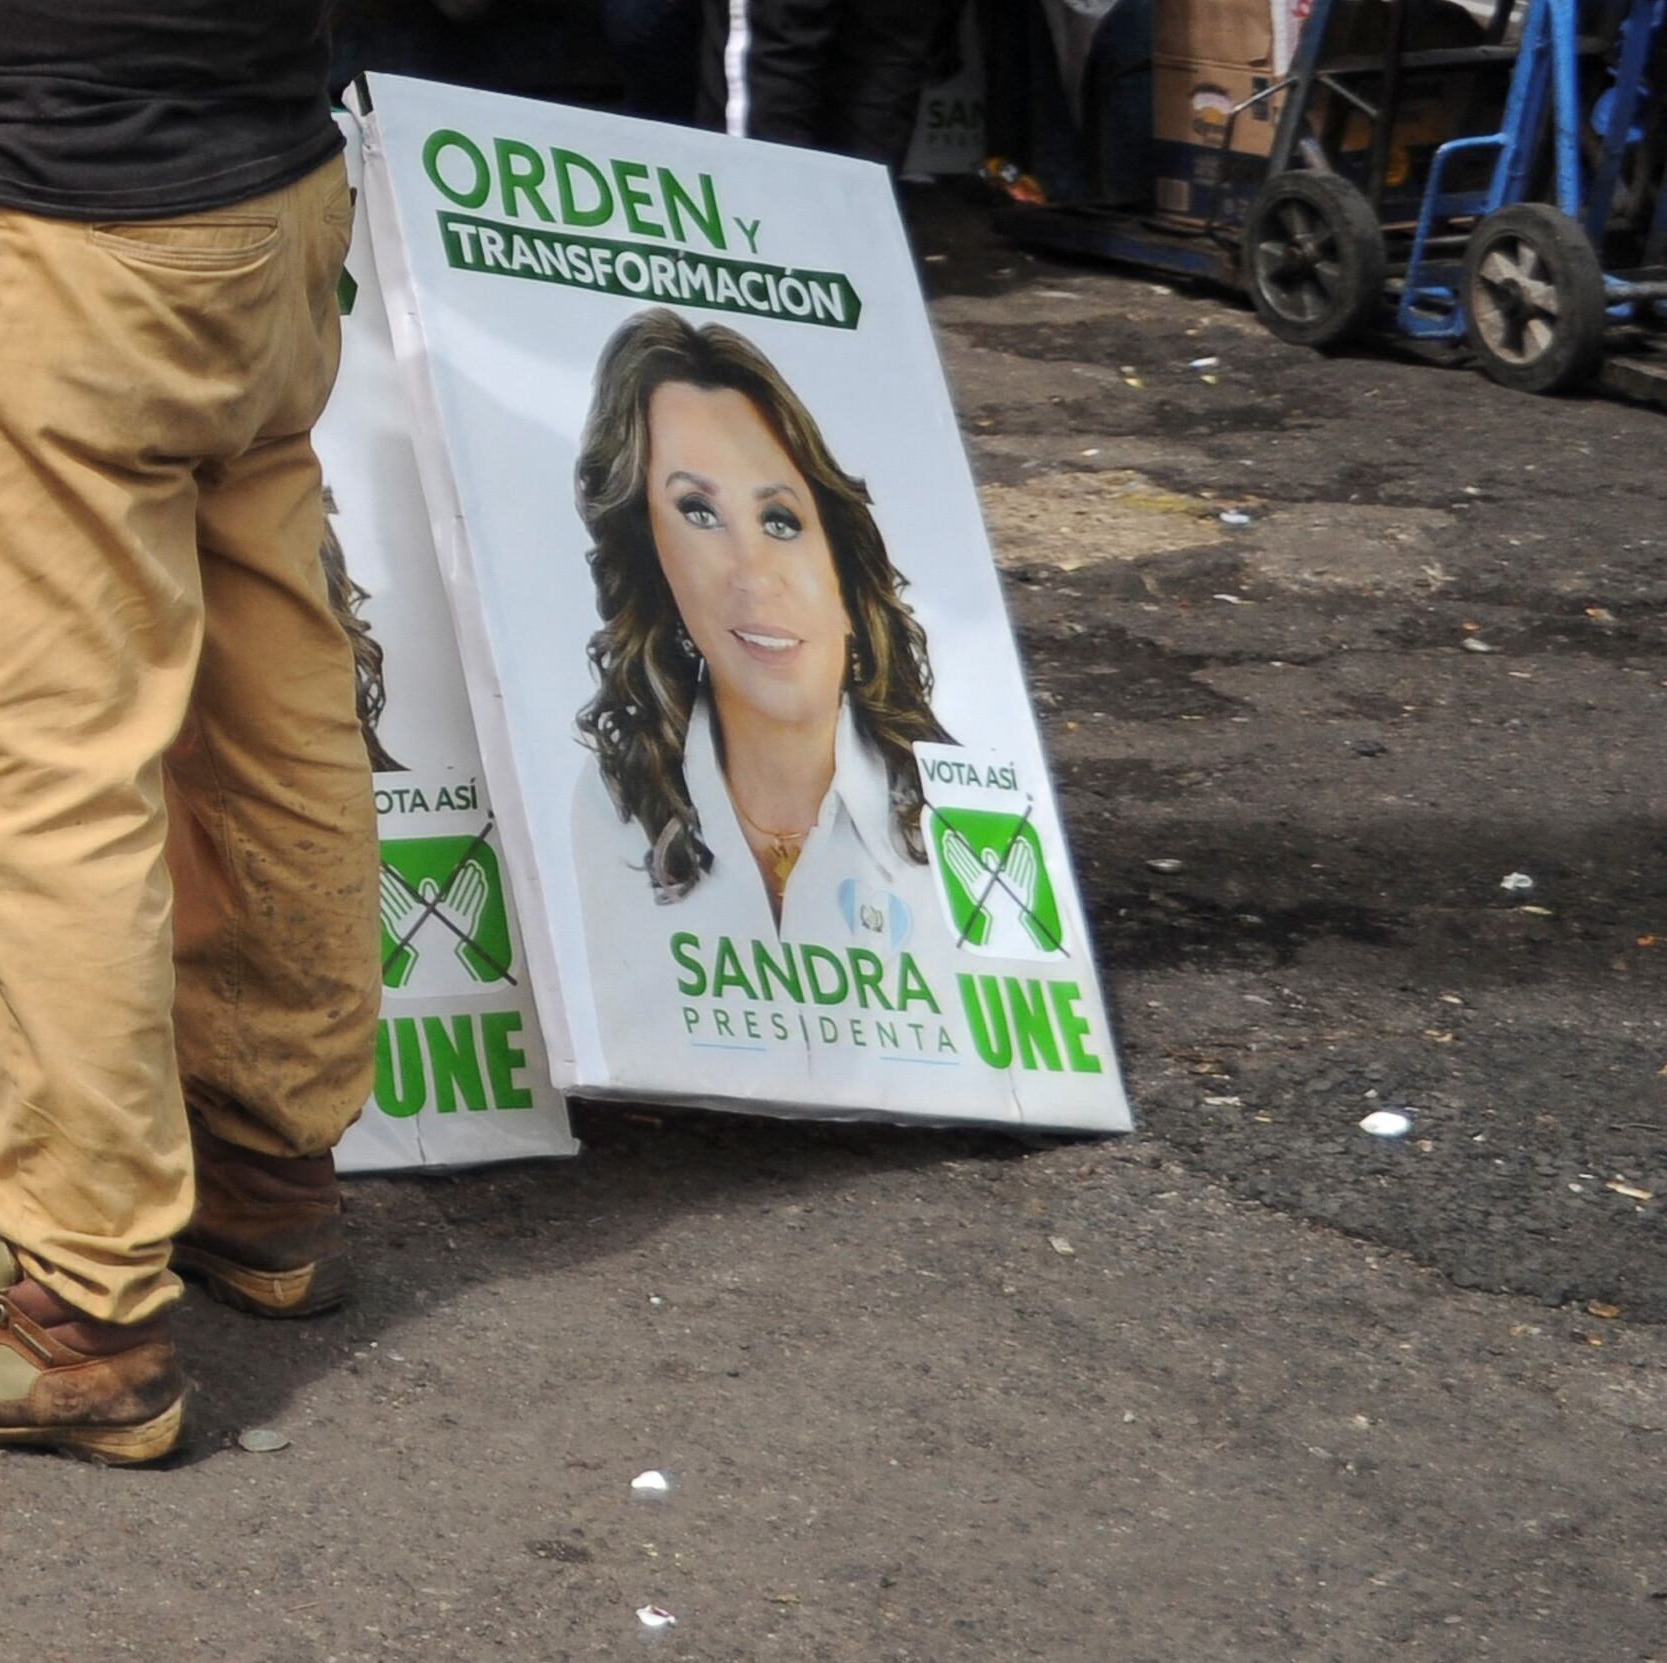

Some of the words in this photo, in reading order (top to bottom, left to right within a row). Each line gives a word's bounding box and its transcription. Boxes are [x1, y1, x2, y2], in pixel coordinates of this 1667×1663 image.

[421, 128, 726, 253] ORDEN
[733, 217, 761, 254] Y
[446, 220, 846, 325] TRANSFORMACIÓN
[374, 788, 430, 815] OTA
[435, 777, 478, 813] ASÍ
[921, 756, 981, 791] VOTA
[983, 756, 1021, 793] ASÍ
[670, 931, 942, 1015] SANDRA
[683, 1005, 960, 1055] PRESIDENTA
[957, 973, 1102, 1074] UNE
[373, 1011, 534, 1118] UNE
